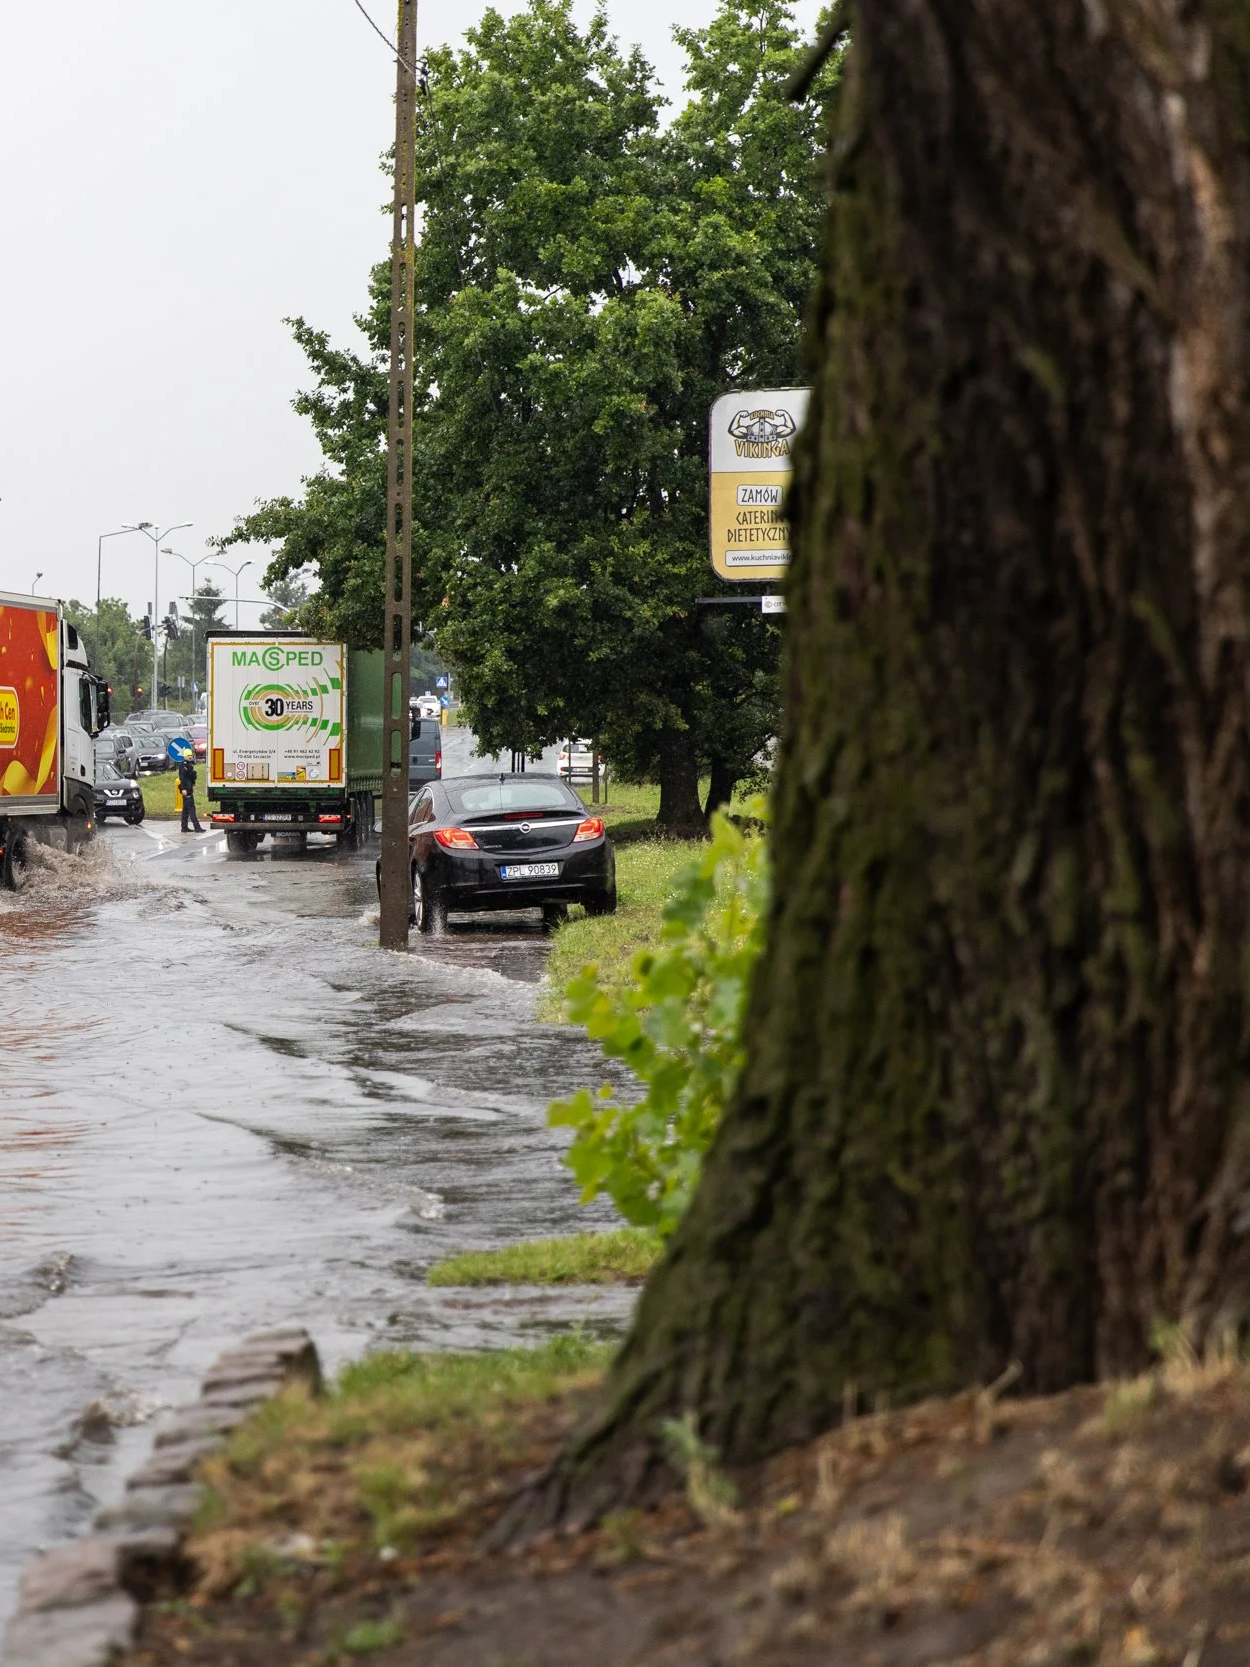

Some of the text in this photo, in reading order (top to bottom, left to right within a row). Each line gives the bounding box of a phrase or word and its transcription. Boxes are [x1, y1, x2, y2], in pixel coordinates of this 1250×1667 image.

[750, 410, 774, 421] KUCHNIA
[734, 439, 790, 458] VIKINGA
[741, 487, 778, 503] ZAMÓW
[5, 702, 15, 720] Cen
[265, 698, 284, 717] 30
[286, 701, 313, 710] YEARS
[507, 867, 525, 877] ZPL
[528, 864, 557, 875] 90839
